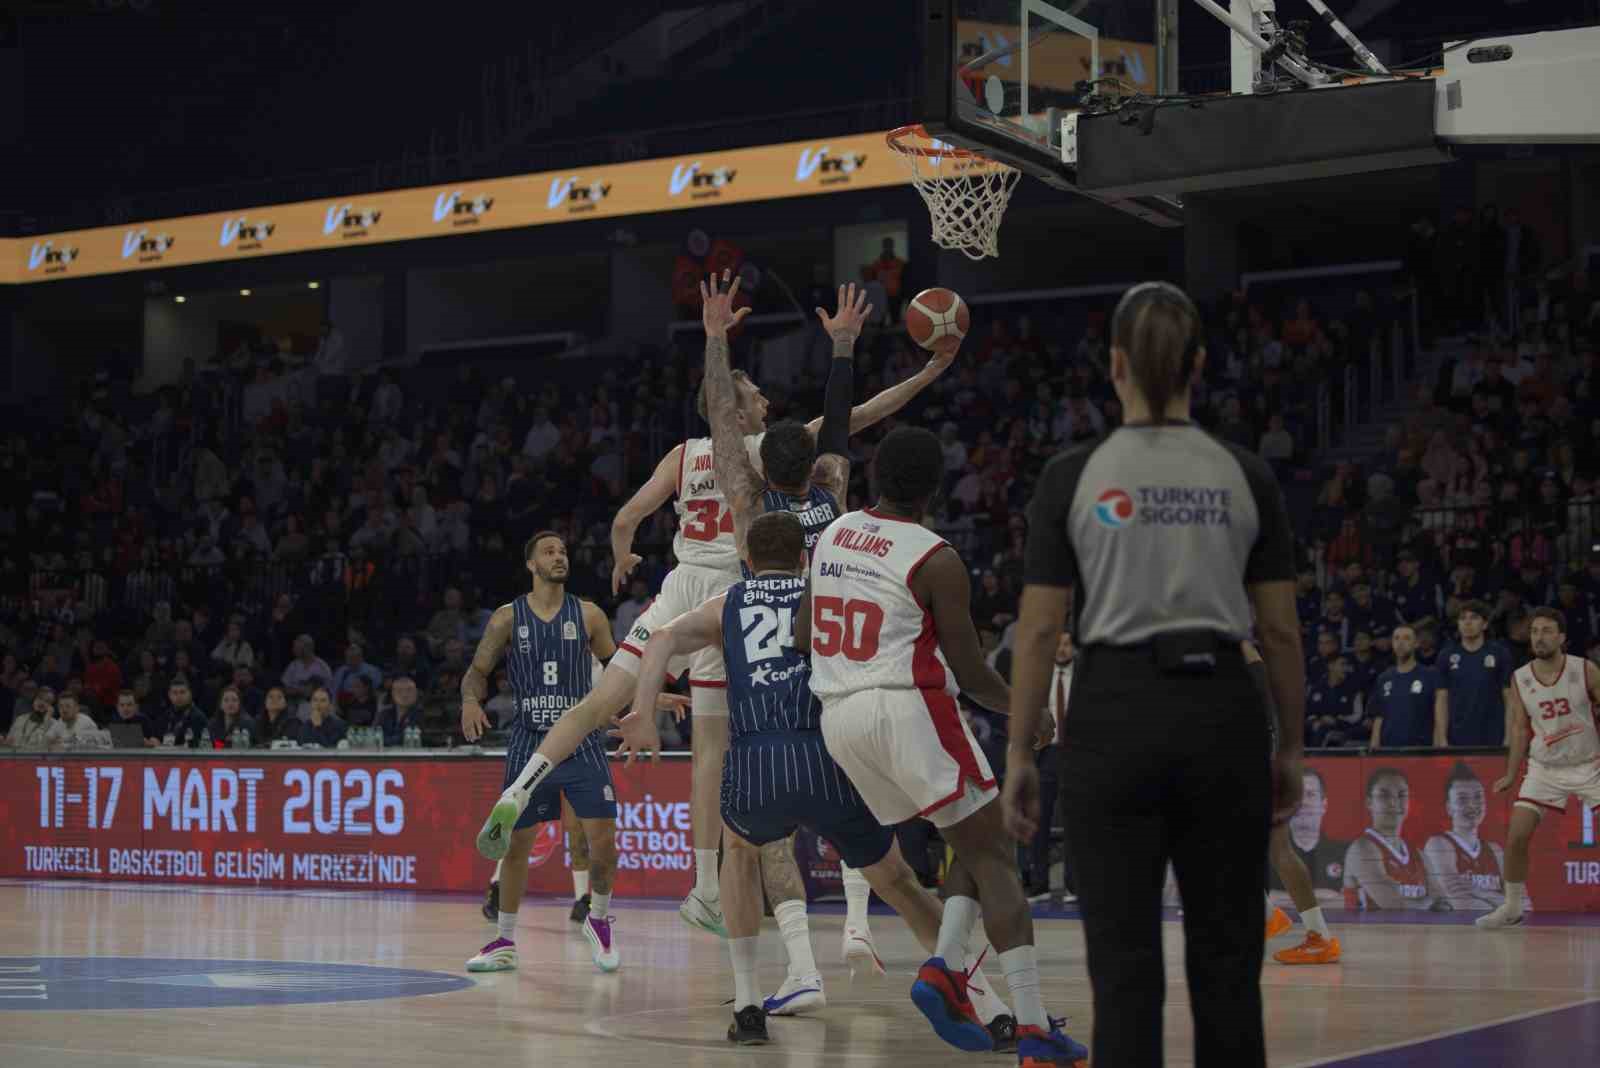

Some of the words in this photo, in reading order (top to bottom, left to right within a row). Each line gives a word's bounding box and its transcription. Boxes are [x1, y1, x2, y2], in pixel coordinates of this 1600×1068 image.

[833, 527, 893, 557] WILLIAMS
[820, 562, 843, 577] BAU
[813, 596, 883, 662] 50
[543, 661, 558, 686] 8
[532, 709, 562, 723] EFE
[1539, 698, 1570, 720] 33
[36, 767, 123, 829] 11-17
[143, 767, 265, 833] MART
[282, 769, 405, 835] 2026
[616, 794, 690, 830] RKİYE
[615, 831, 692, 852] KETBOL
[24, 845, 102, 874] TURKCELL
[109, 848, 207, 878] BASKETBOL
[214, 847, 286, 884] GELİŞİM
[292, 850, 417, 885] MERKEZİ'NDE
[617, 852, 691, 871] ASYONU
